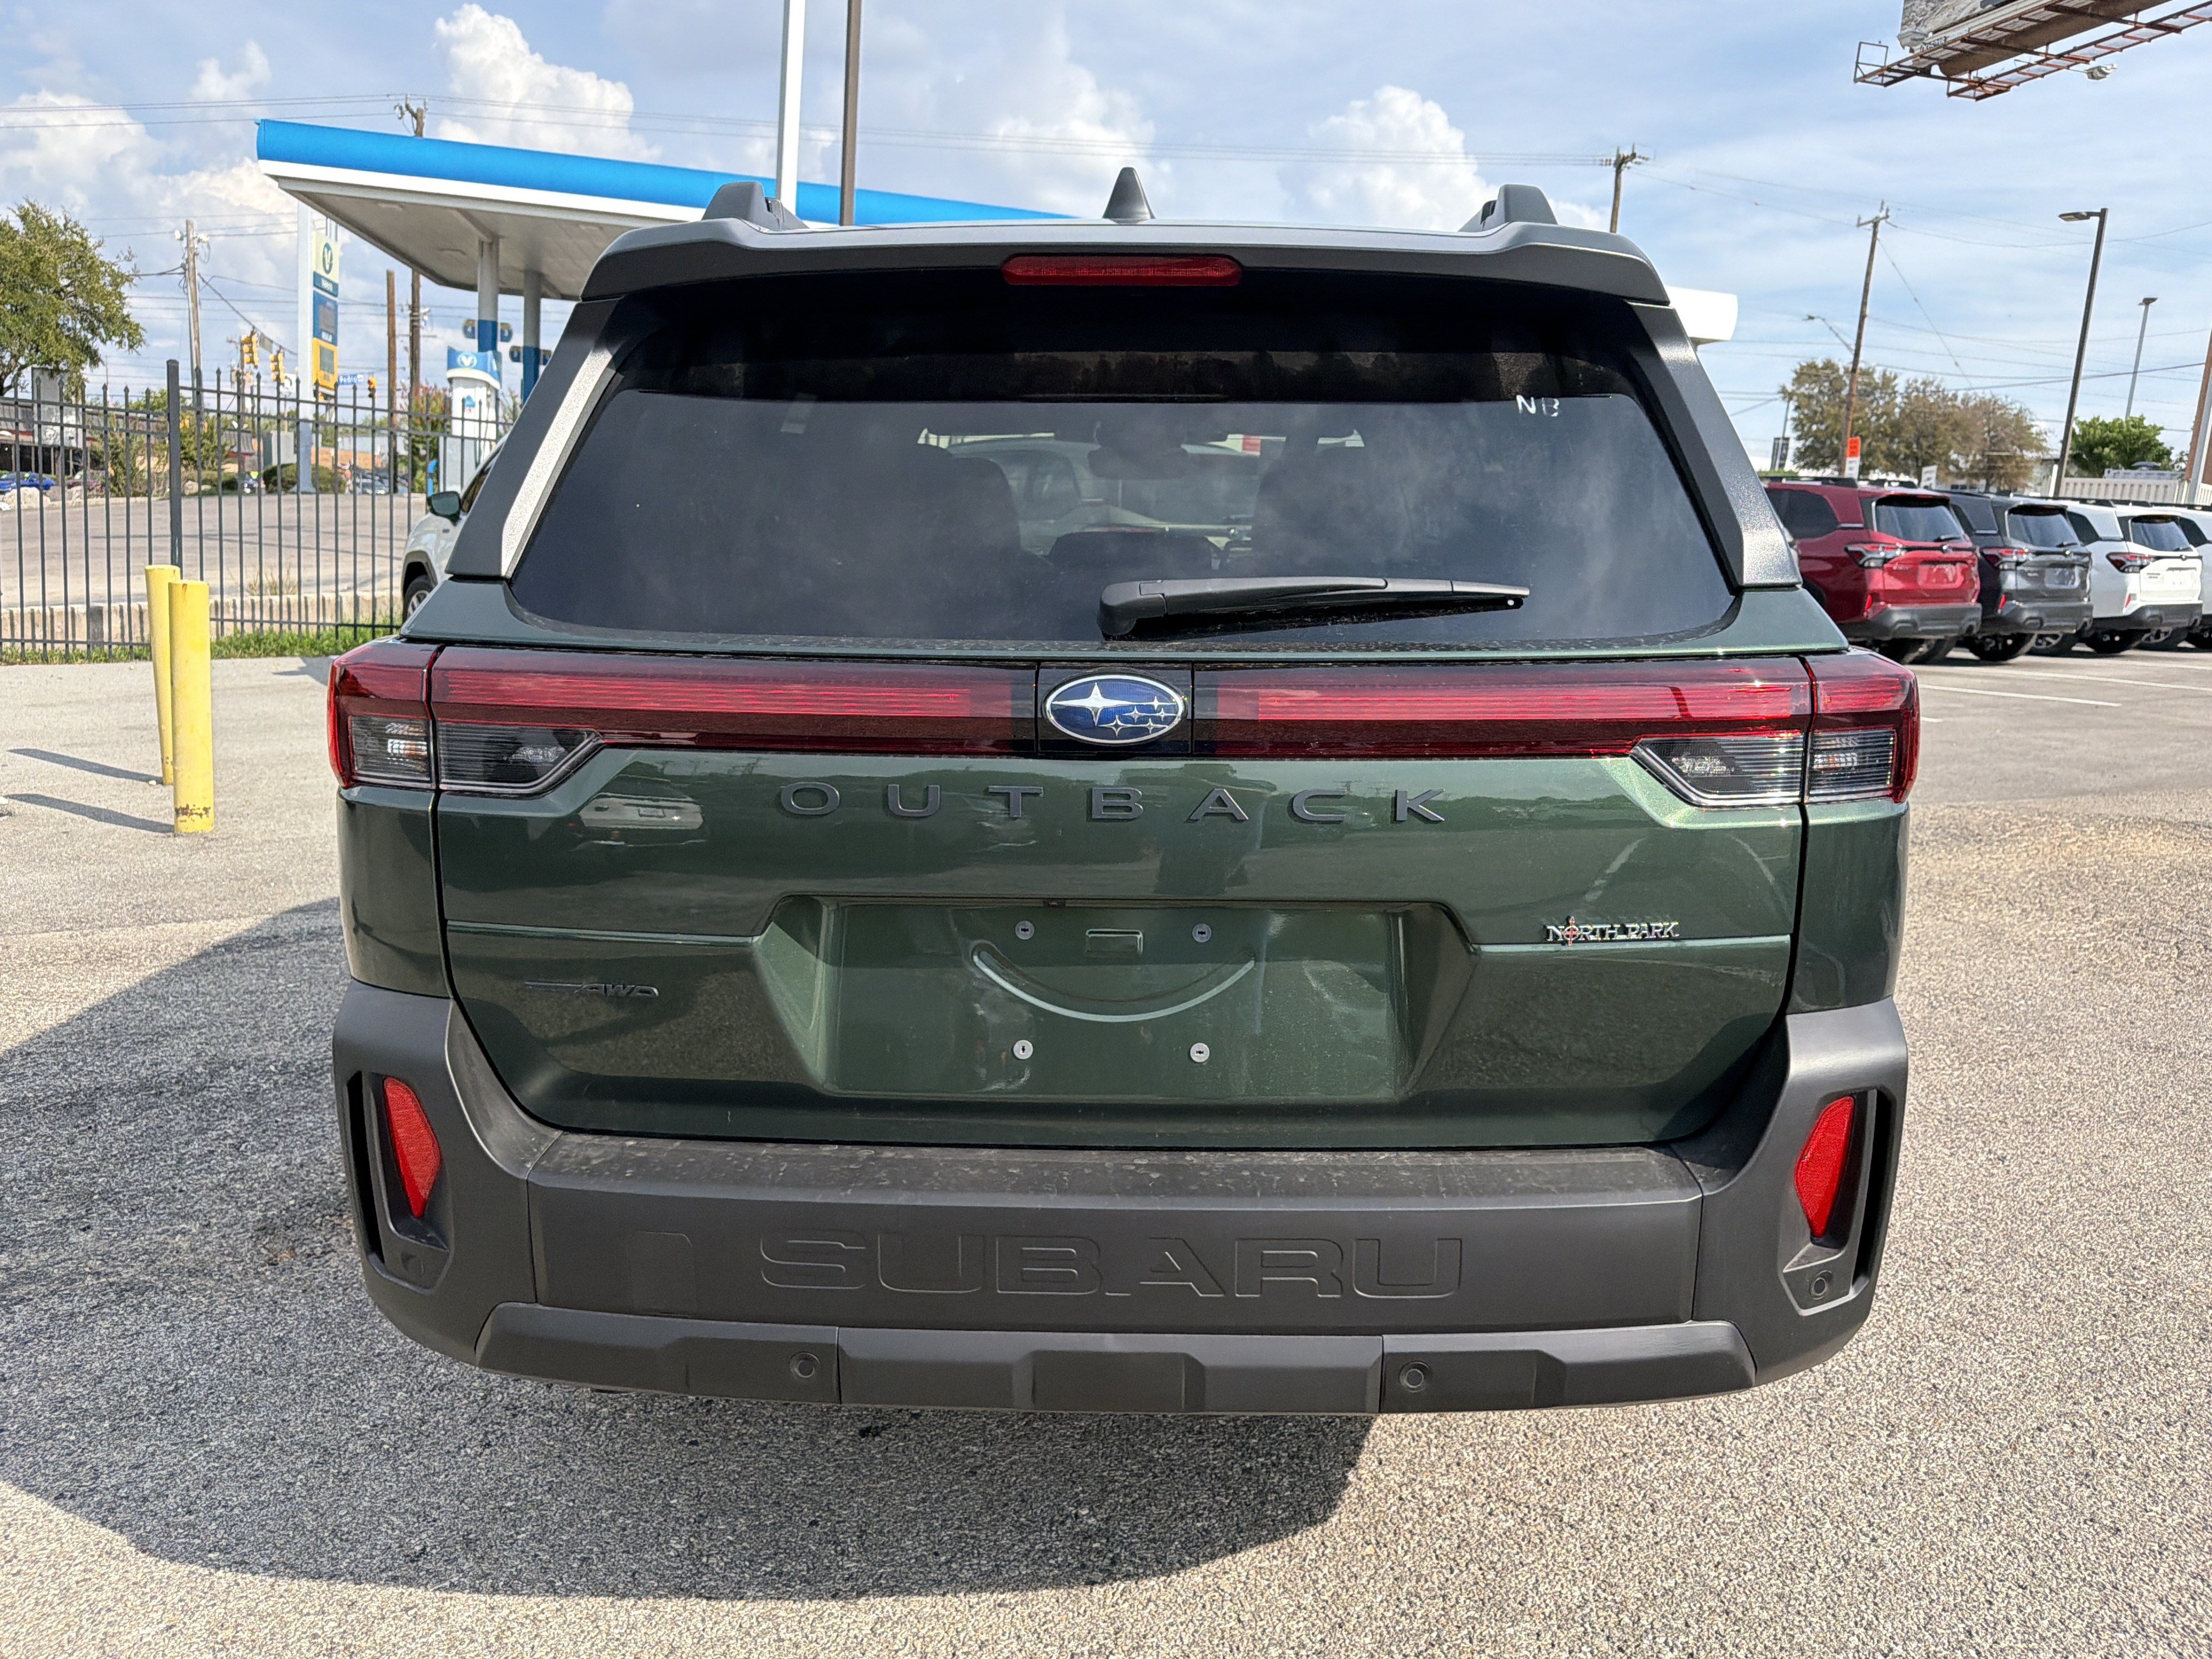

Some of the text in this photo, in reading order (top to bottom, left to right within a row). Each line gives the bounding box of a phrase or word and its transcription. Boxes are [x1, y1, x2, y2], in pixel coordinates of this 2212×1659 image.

[779, 781, 1446, 823] OUTBACK
[1545, 921, 1680, 943] NORTH PARK
[760, 1229, 1463, 1299] SUBARU
